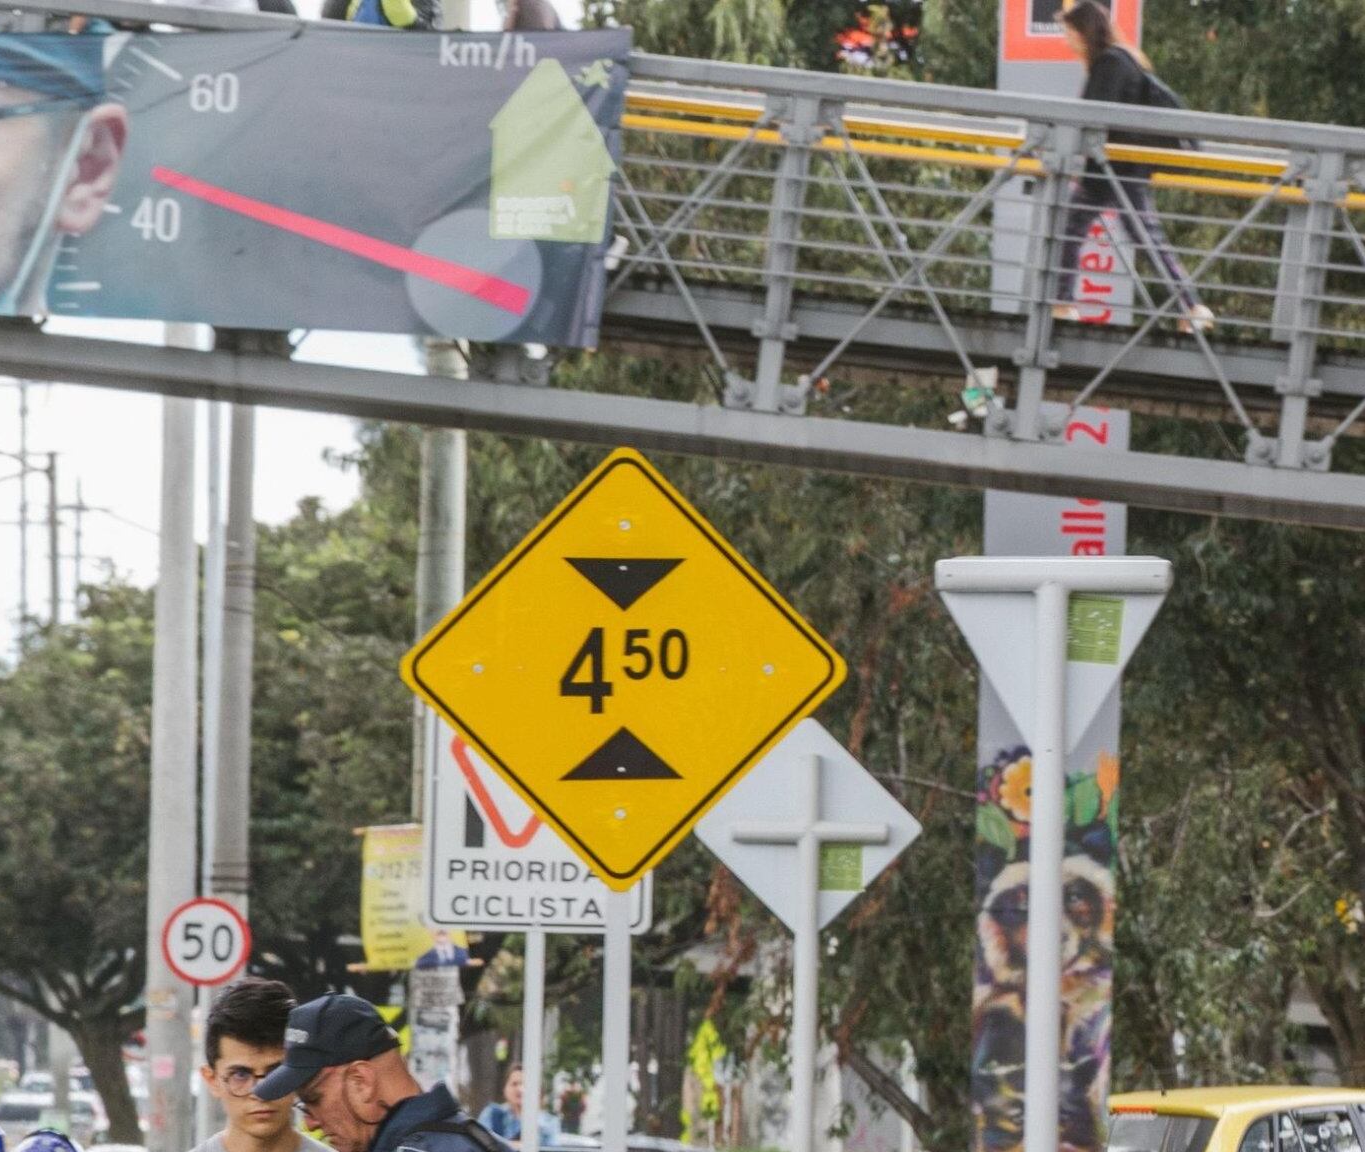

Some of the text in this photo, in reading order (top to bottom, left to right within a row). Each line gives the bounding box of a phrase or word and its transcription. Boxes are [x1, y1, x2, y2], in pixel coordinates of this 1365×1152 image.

[440, 34, 536, 70] km/h
[189, 72, 239, 113] 60
[131, 197, 181, 241] 40
[448, 859, 602, 883] PRIORIDA
[451, 895, 602, 918] CICLISTA
[181, 923, 234, 962] 50
